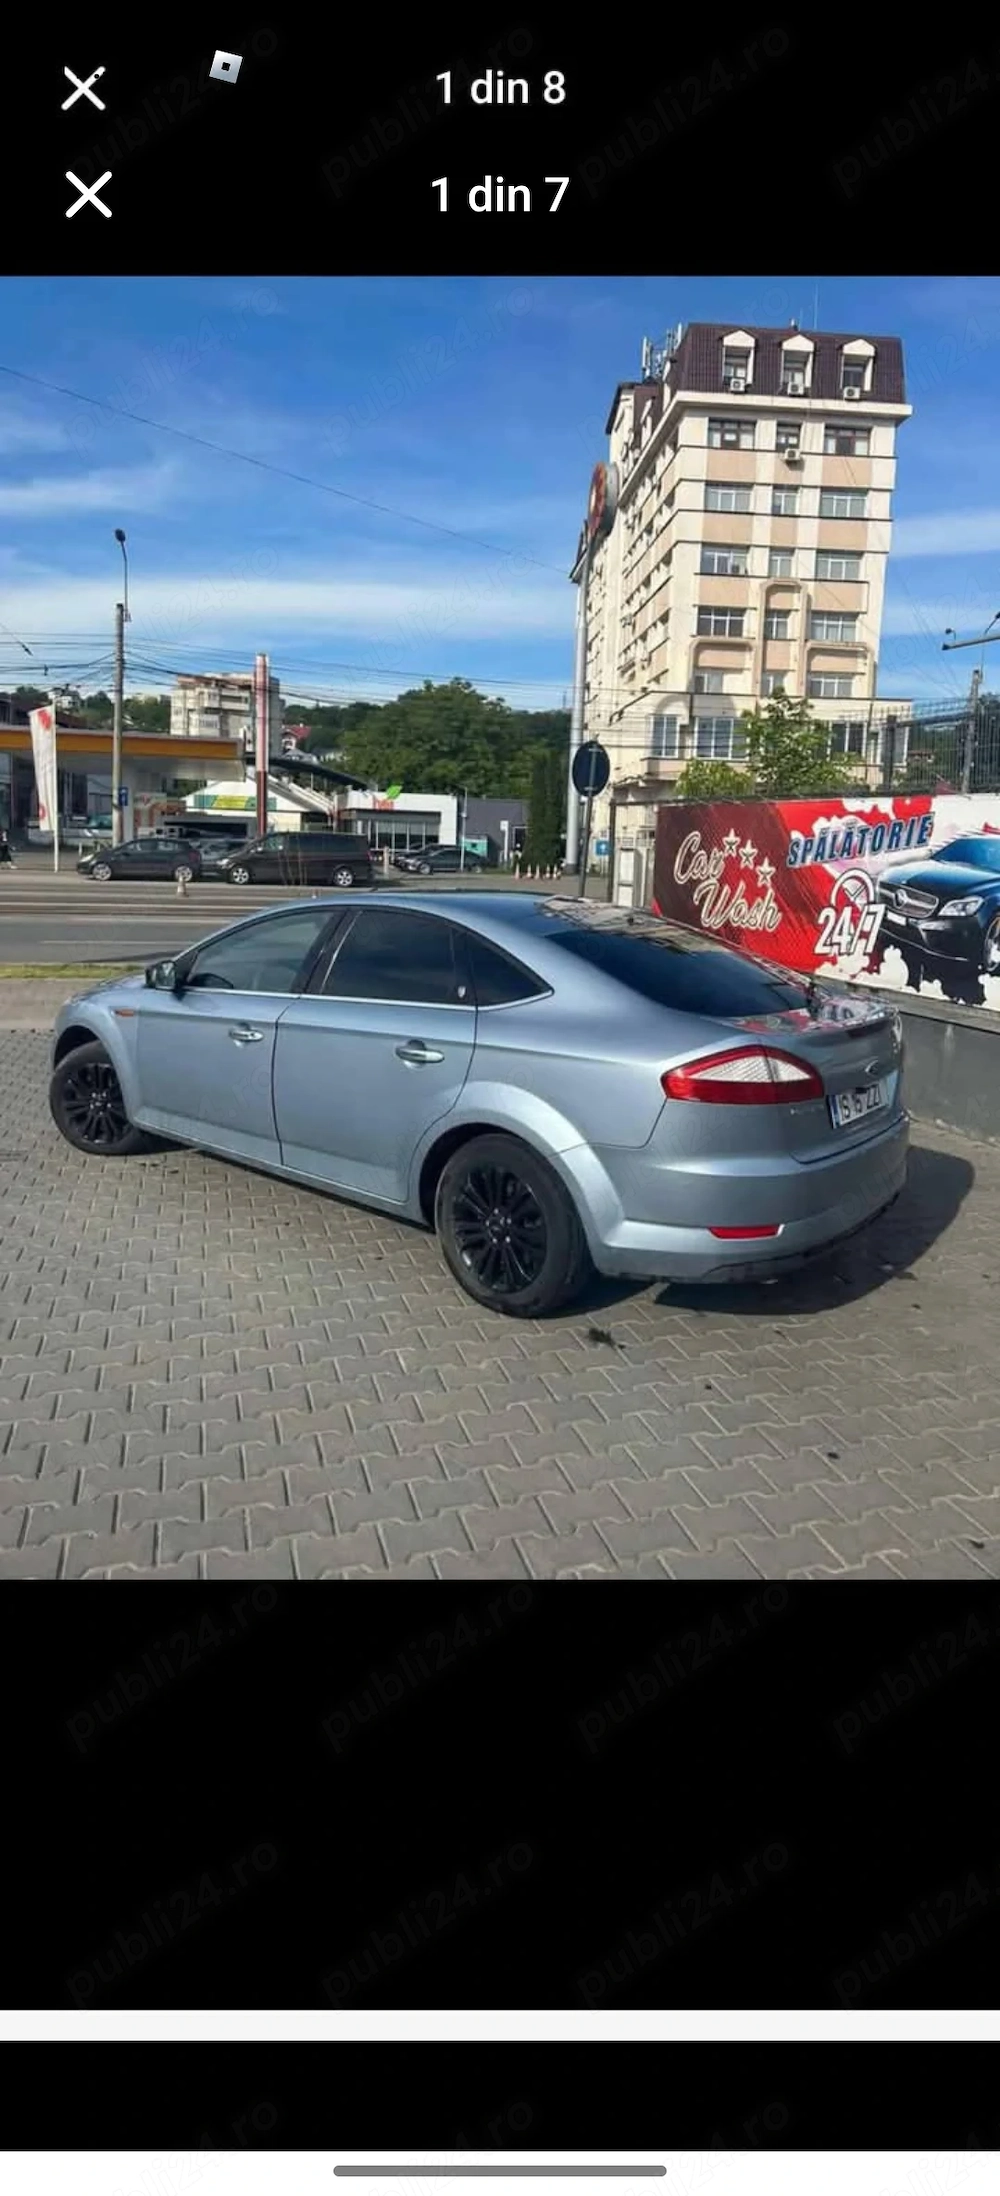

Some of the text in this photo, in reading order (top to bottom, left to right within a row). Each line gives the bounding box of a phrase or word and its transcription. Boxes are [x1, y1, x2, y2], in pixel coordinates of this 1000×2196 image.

[674, 831, 725, 884] Car
[786, 812, 935, 868] SPĂLĂTORIE
[693, 880, 783, 933] Wash
[813, 903, 886, 957] 24/7
